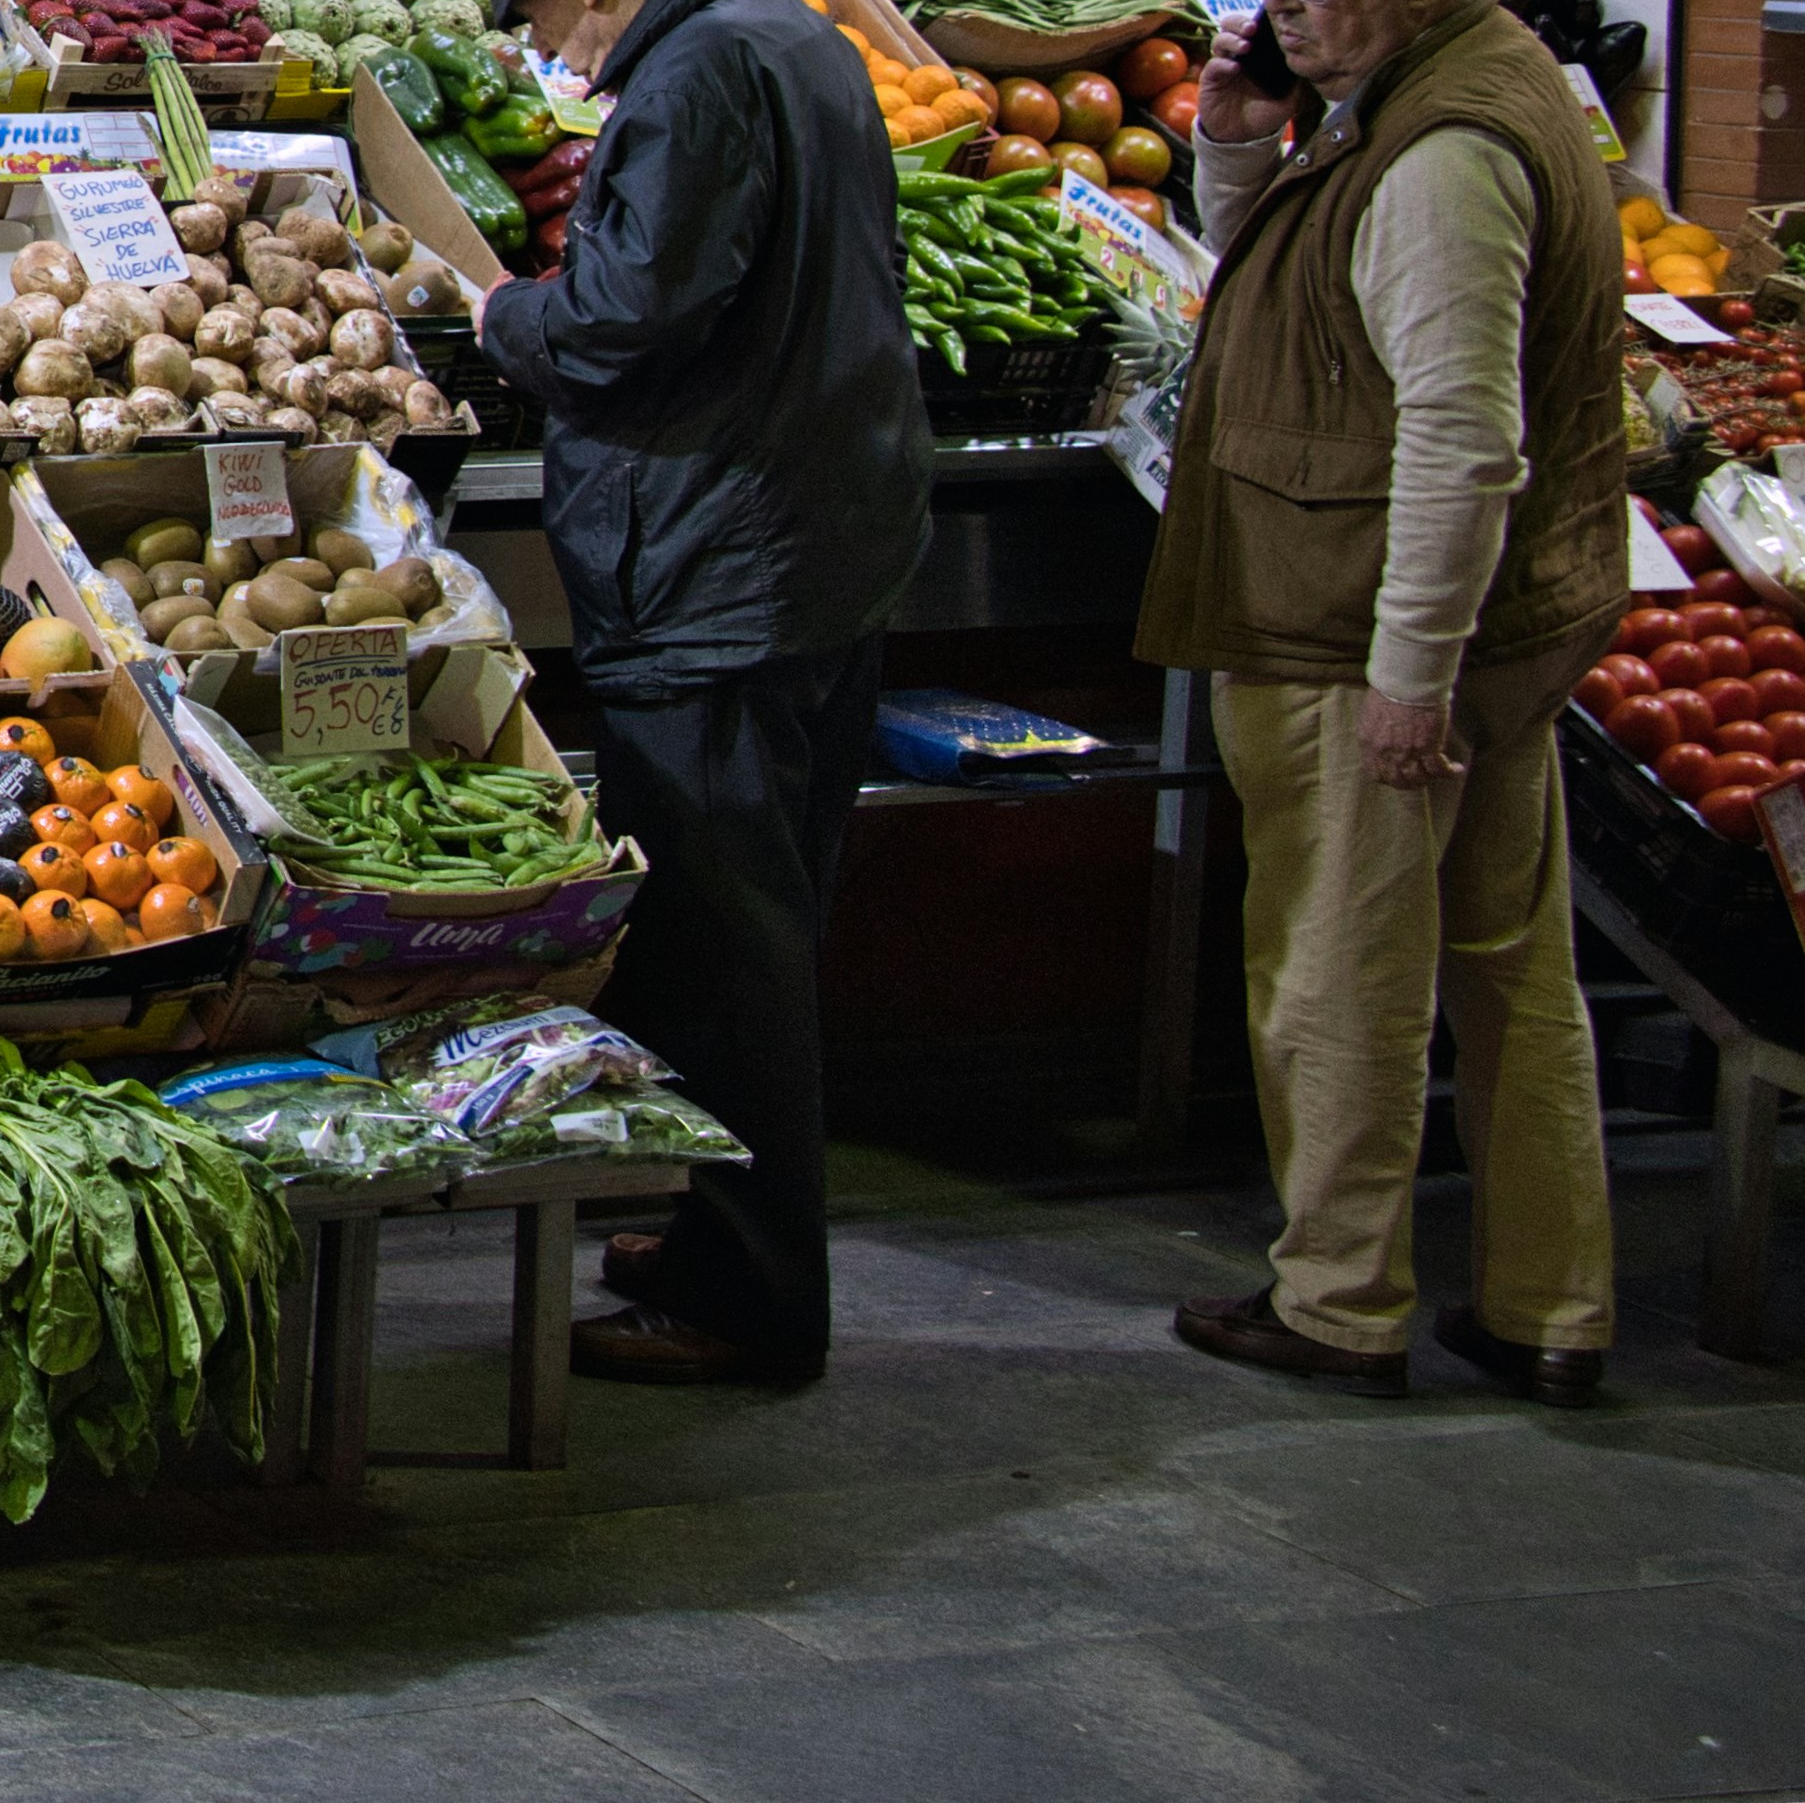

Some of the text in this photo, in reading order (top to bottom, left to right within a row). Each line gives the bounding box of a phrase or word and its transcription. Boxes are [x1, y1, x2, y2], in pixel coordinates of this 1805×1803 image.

[104, 71, 144, 94] Sol
[1067, 176, 1143, 241] Frutas
[115, 243, 138, 261] DE
[217, 448, 265, 473] KIWI
[223, 476, 263, 497] GOLD
[290, 629, 400, 663] OFERTA
[290, 682, 380, 747] 5,50
[217, 799, 244, 835] QUALITY
